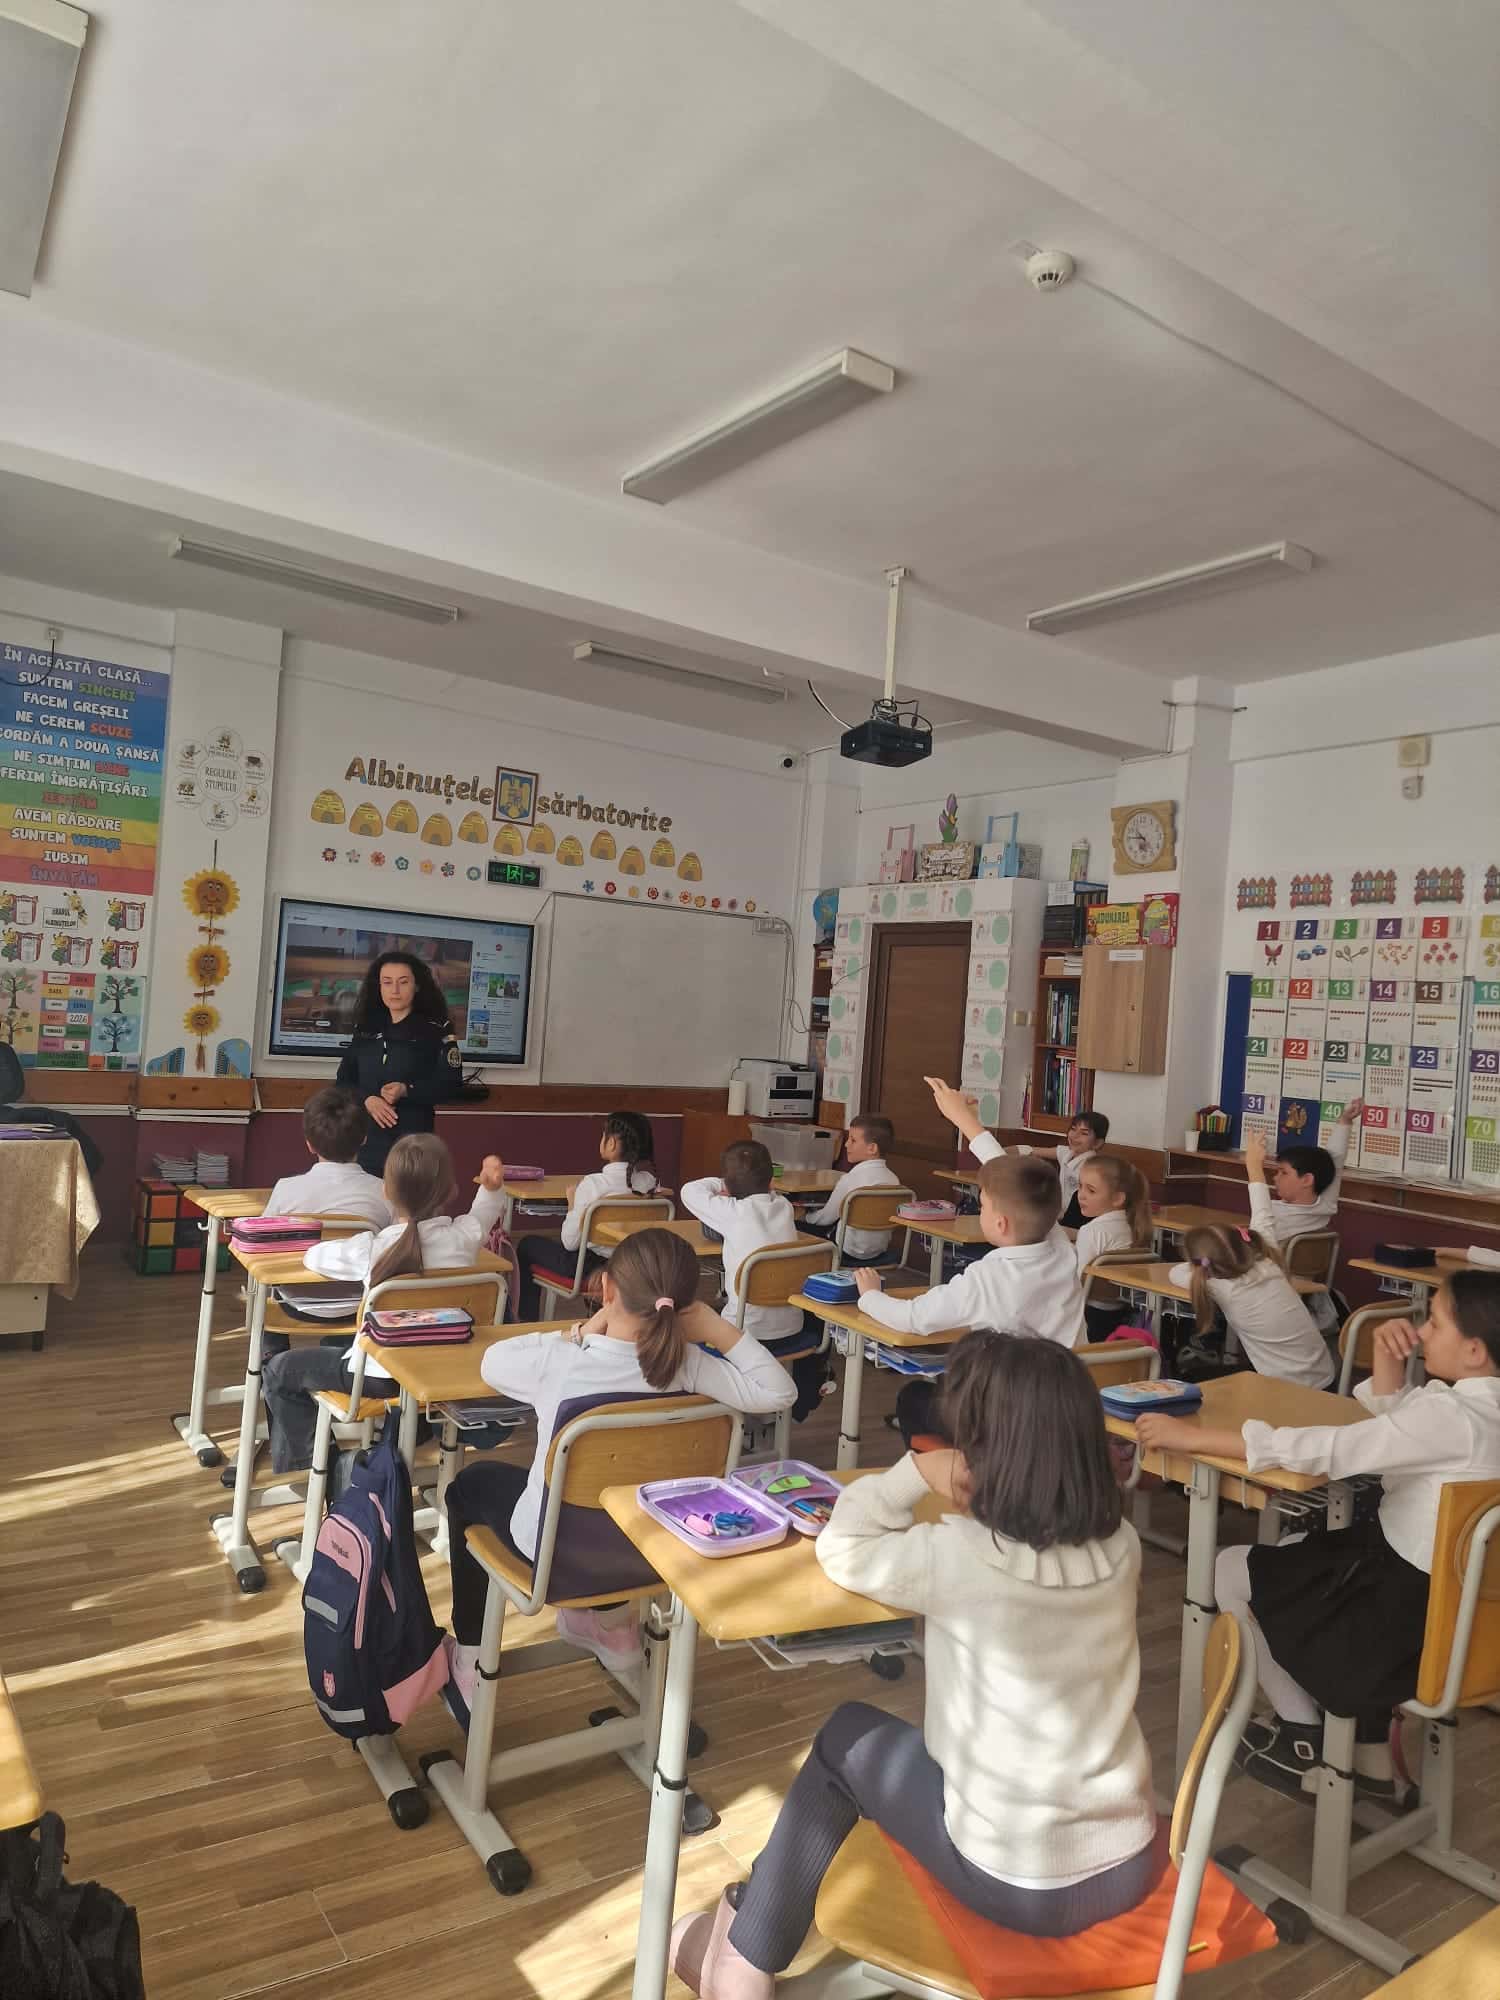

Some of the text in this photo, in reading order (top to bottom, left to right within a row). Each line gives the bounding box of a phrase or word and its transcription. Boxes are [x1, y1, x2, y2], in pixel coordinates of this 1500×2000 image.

[5, 646, 22, 662] ÎN
[28, 653, 91, 675] ACEASTĂ
[18, 671, 135, 702] SUNTEM SINCERI
[23, 691, 129, 719] FACEM GREȘELI
[15, 710, 133, 739] NE CEREM SCUZE
[59, 736, 68, 749] A
[75, 739, 110, 754] DOUA
[14, 750, 32, 762] NE
[38, 753, 90, 771] SIMȚIM
[344, 756, 494, 805] Albinuțele
[536, 792, 673, 834] sărbatorite
[14, 808, 121, 831] AVEM RĂBDARE
[11, 828, 66, 843] SUNTEM
[43, 850, 88, 865] IUBIM
[1266, 922, 1272, 936] 1
[1302, 922, 1312, 935] 2
[1342, 922, 1351, 935] 3
[1384, 921, 1394, 935] 4
[1431, 919, 1441, 934] 5
[1256, 980, 1269, 993] 11
[1295, 981, 1310, 994] 12
[1334, 982, 1350, 995] 13
[1376, 983, 1393, 997] 14
[1421, 984, 1439, 998] 15
[1481, 985, 1500, 999] 16
[1250, 1040, 1265, 1052] 21
[1289, 1042, 1305, 1055] 22
[1329, 1044, 1346, 1057] 23
[1372, 1047, 1389, 1060] 24
[1417, 1050, 1436, 1063] 25
[1476, 1054, 1496, 1068] 26
[1248, 1097, 1262, 1109] 31
[1324, 1104, 1341, 1117] 40
[1367, 1109, 1384, 1122] 50
[1411, 1114, 1430, 1128] 60
[1472, 1120, 1492, 1135] 70
